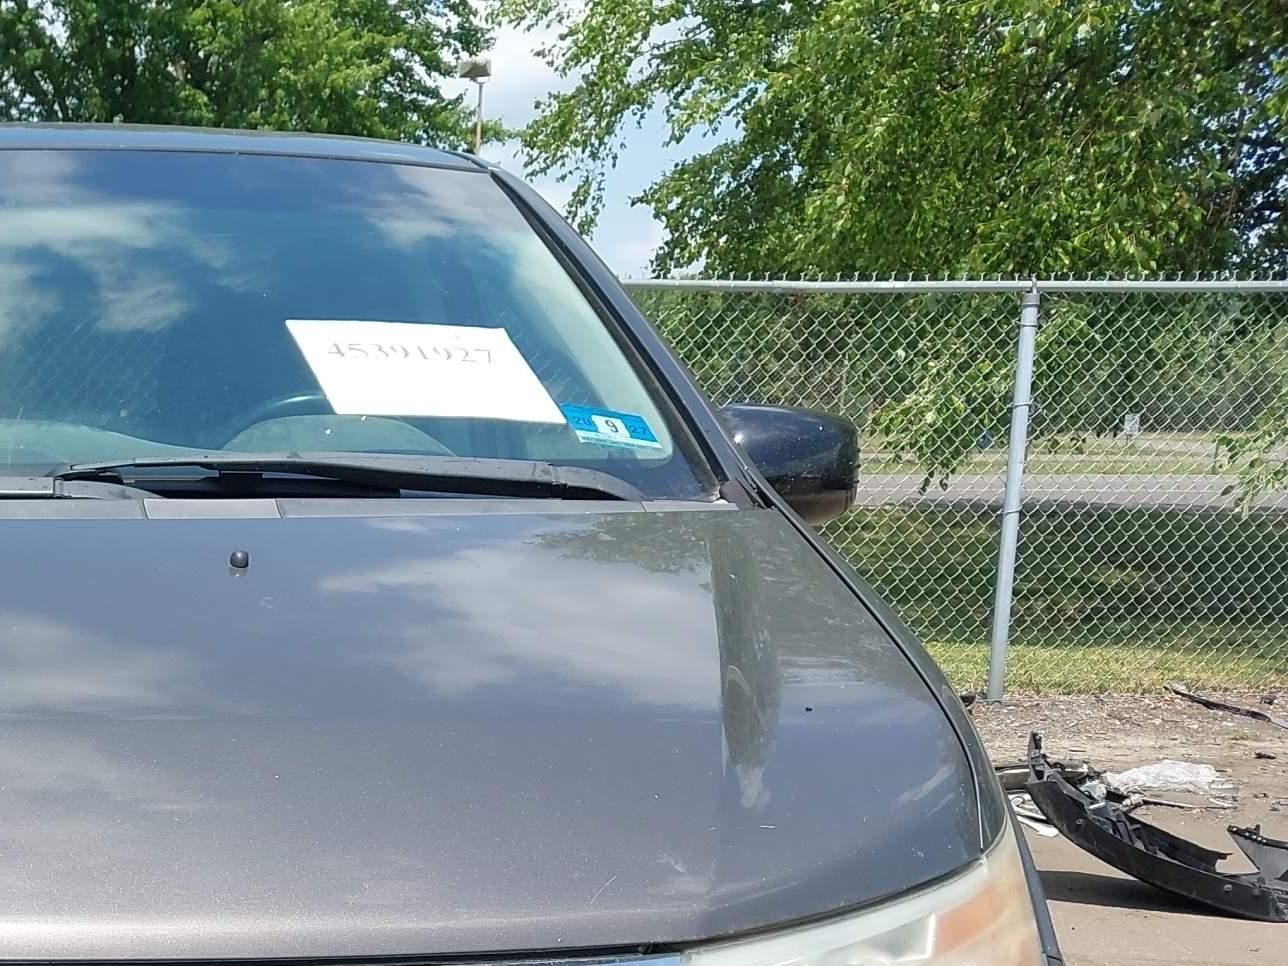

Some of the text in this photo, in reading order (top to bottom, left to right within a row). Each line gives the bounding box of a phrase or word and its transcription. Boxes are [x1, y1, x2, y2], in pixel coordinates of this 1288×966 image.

[328, 343, 492, 364] 45391927
[604, 419, 619, 434] 9
[627, 424, 647, 436] 27
